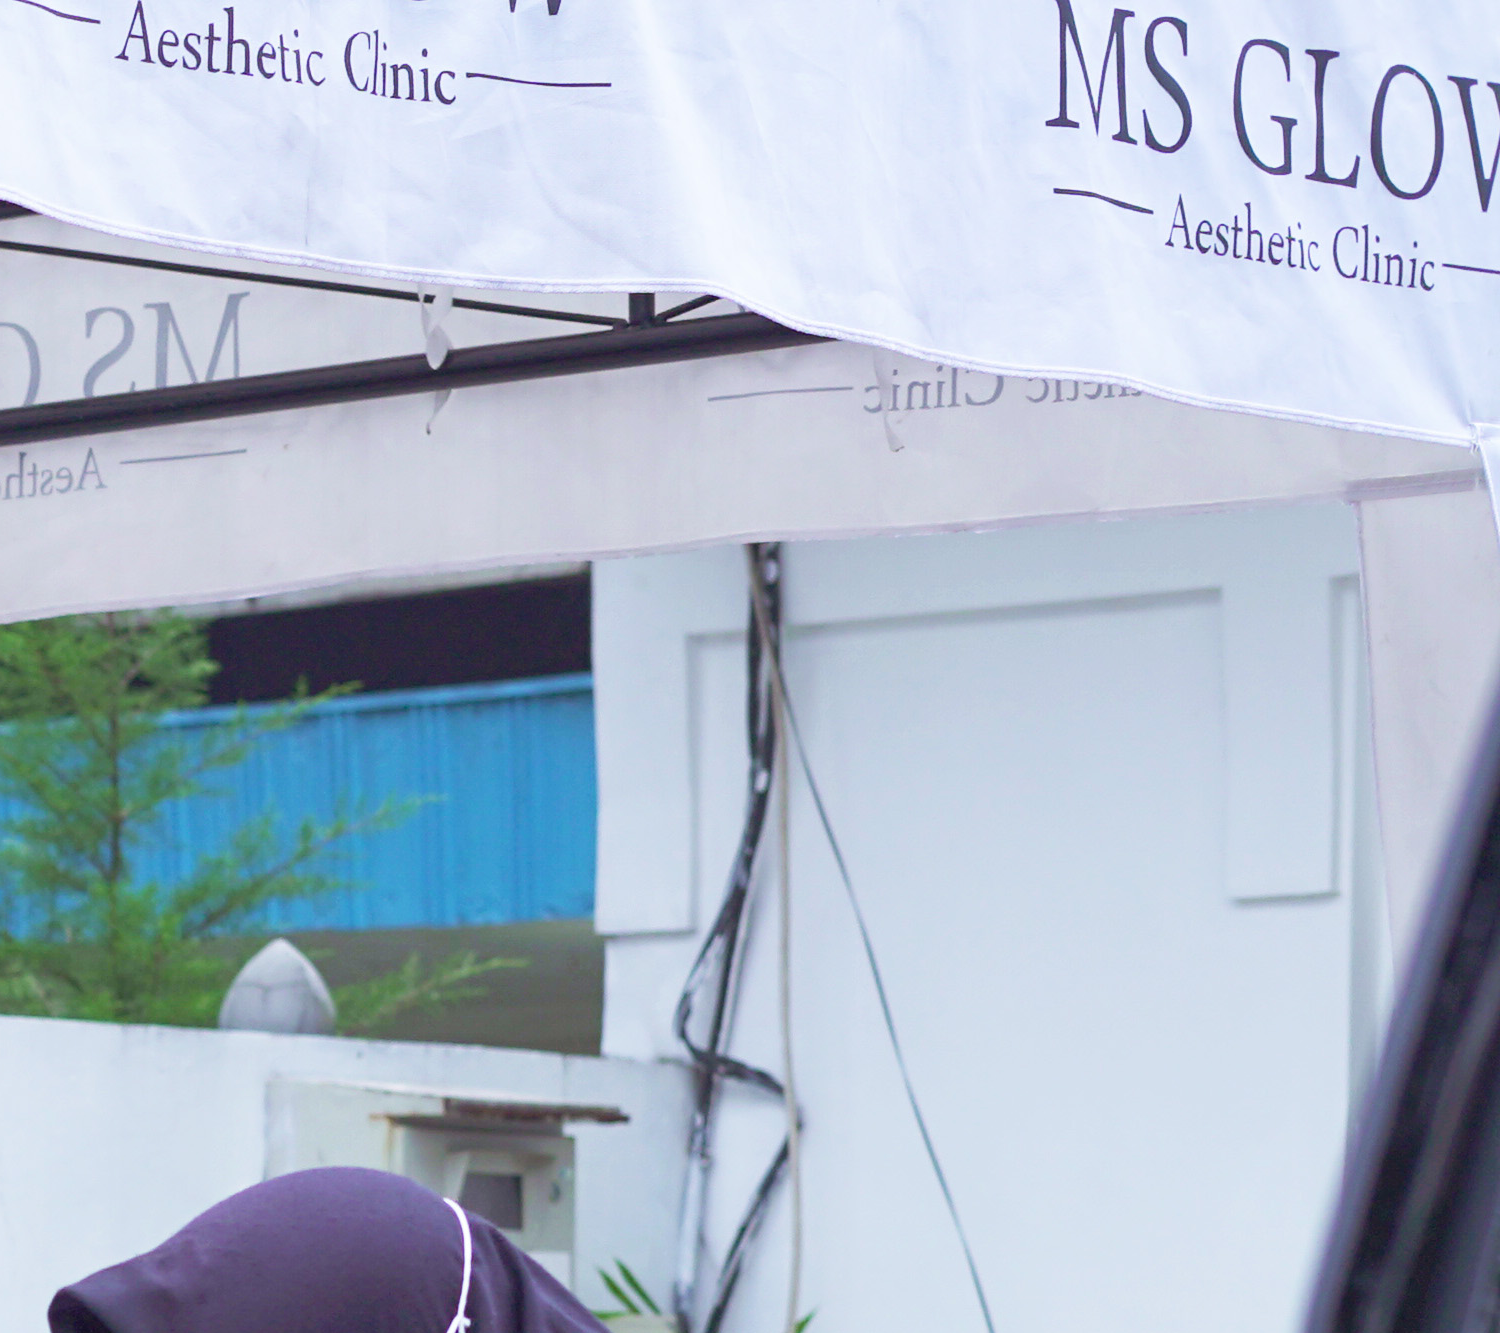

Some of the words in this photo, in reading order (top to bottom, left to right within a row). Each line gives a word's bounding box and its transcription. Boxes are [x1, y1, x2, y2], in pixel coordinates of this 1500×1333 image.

[116, 0, 327, 87] Aesthetic
[343, 30, 458, 106] Clinic
[1045, 0, 1193, 154] MS
[1165, 193, 1322, 273] Aesthetic
[1332, 224, 1436, 292] Clinic
